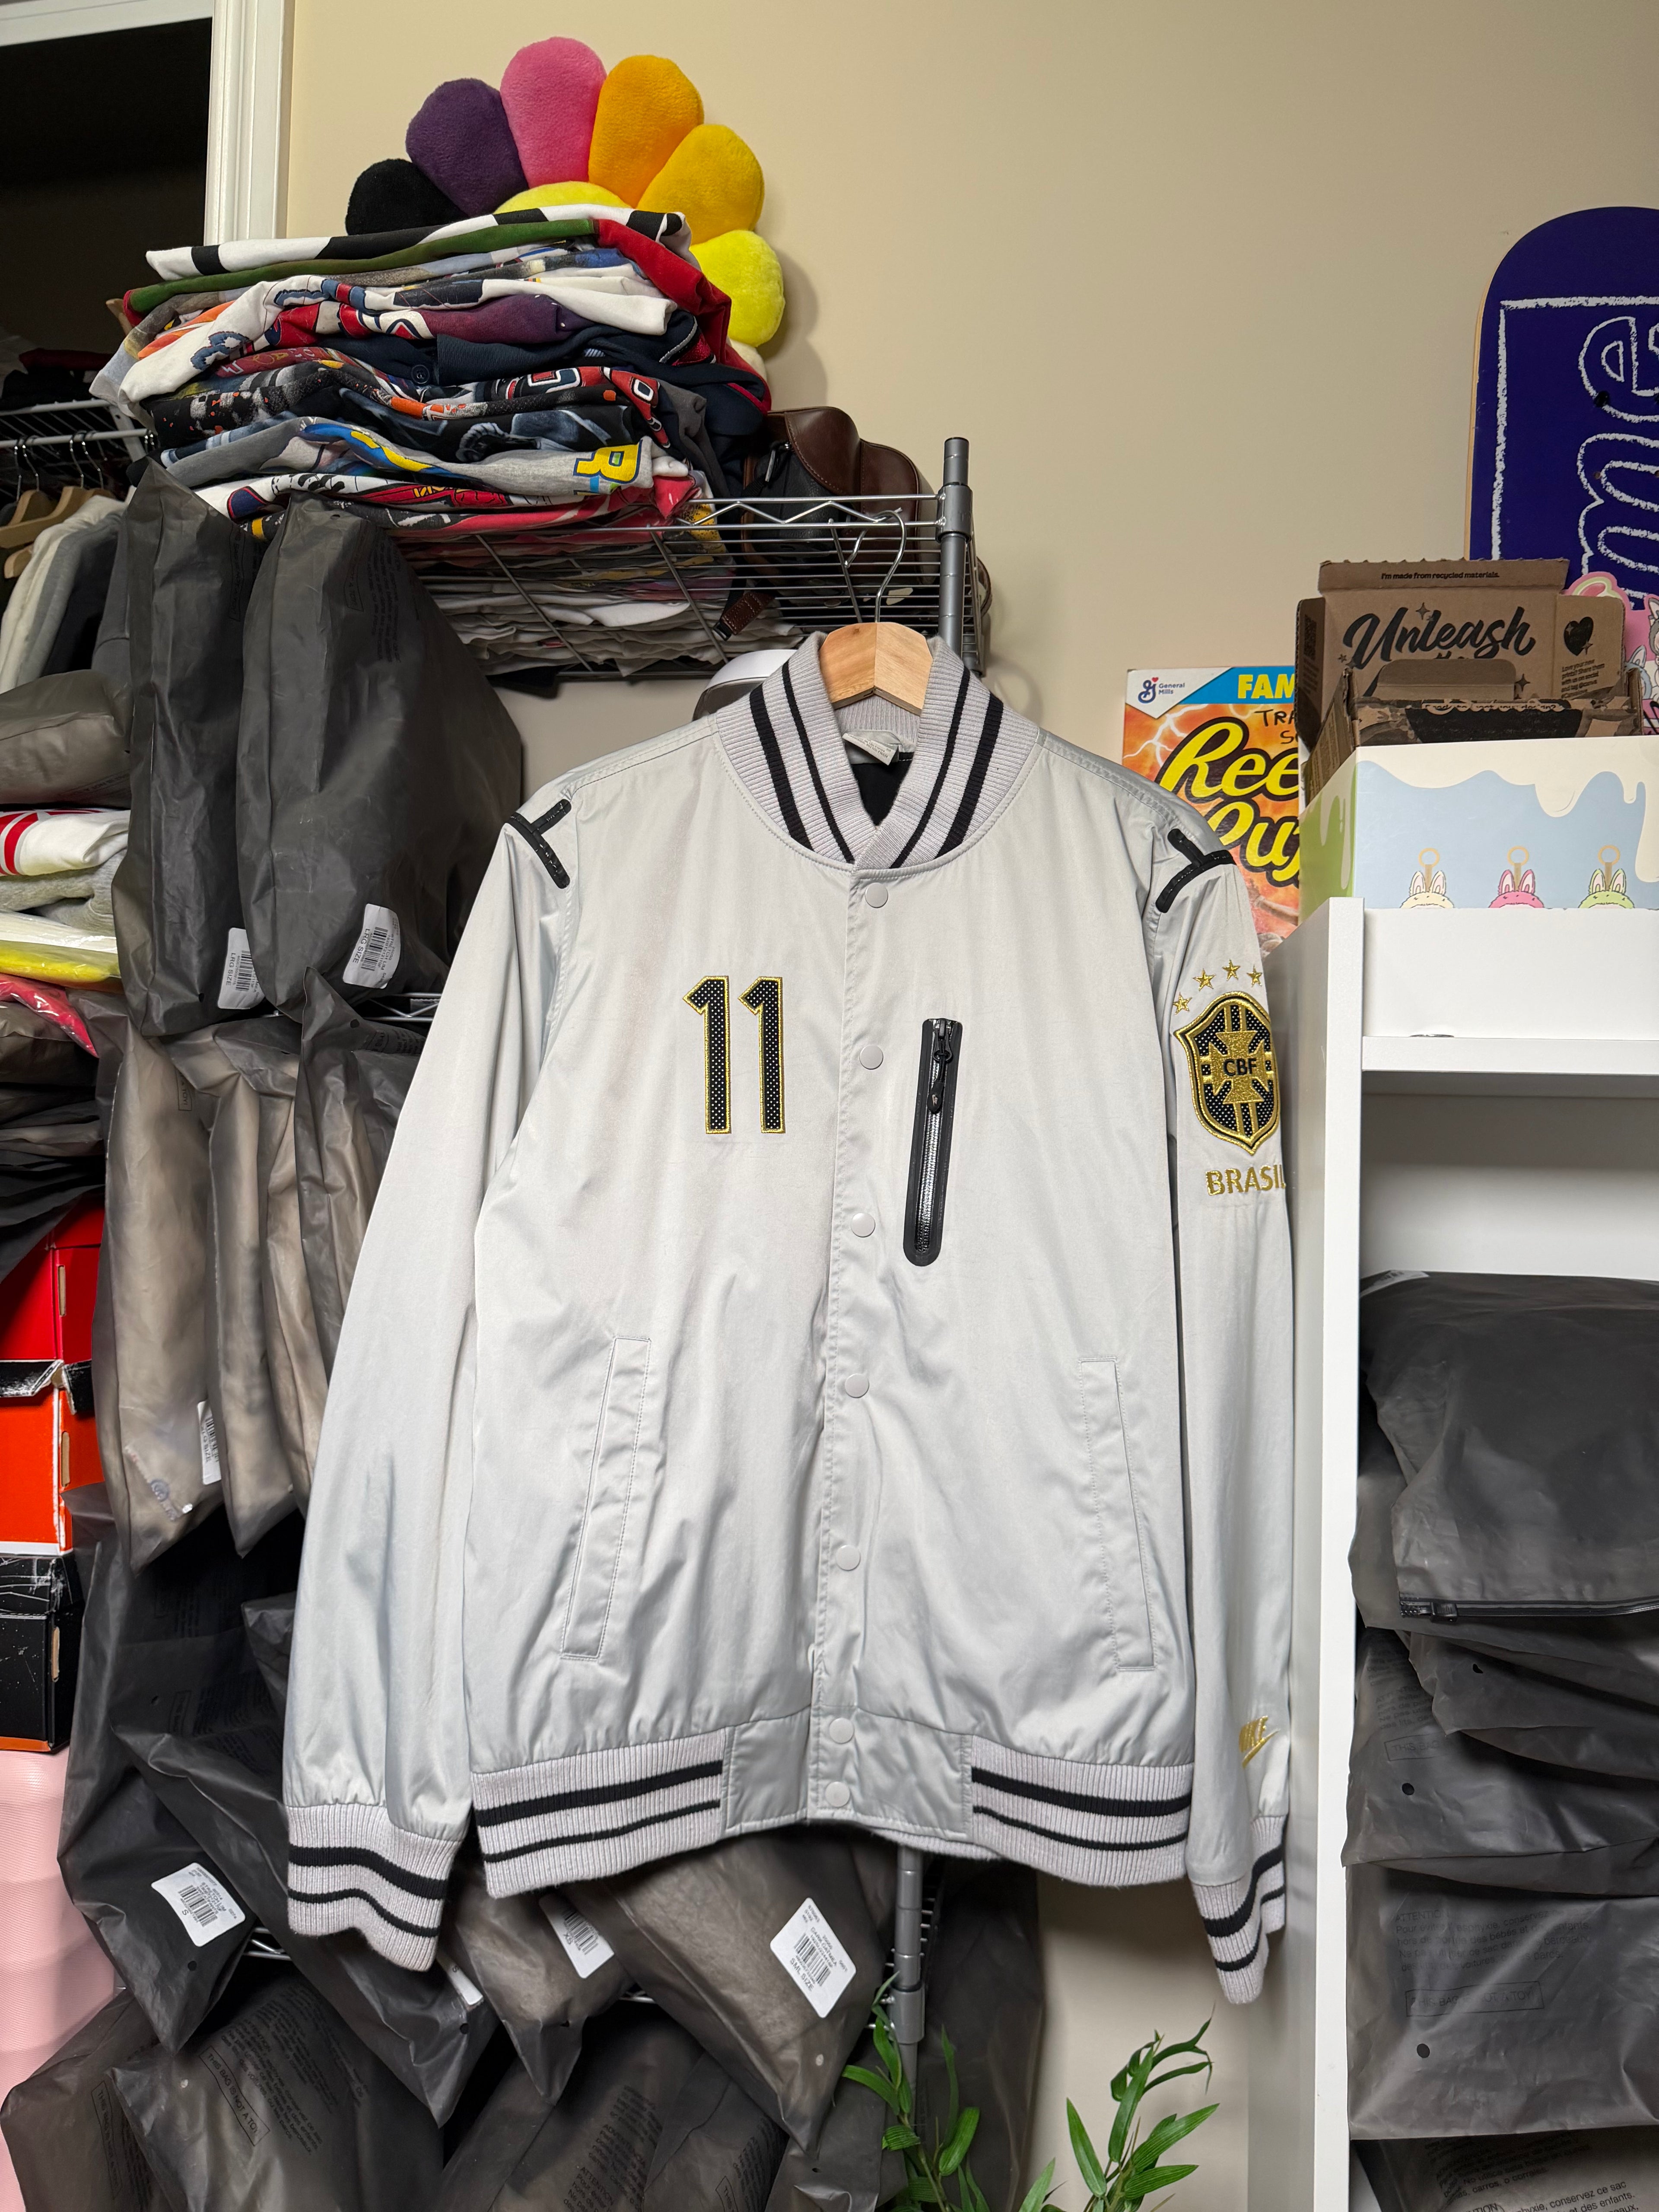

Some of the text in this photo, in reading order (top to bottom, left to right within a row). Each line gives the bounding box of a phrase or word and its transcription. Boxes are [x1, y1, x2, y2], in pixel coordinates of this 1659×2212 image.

[1343, 606, 1536, 669] Unleash
[352, 928, 370, 964] LRG SIZE
[226, 969, 234, 986] SIZE
[683, 976, 785, 1134] 11
[1223, 1058, 1258, 1077] CBF
[1205, 1164, 1286, 1196] BRASIL
[181, 1908, 189, 1916] S
[563, 1932, 574, 1945] XS
[1519, 1925, 1528, 1934] et
[788, 1957, 816, 1992] SML SIZE
[206, 2051, 251, 2120] THIS BAG IS NOT A
[1472, 2180, 1502, 2193] carros,
[1549, 2181, 1627, 2208] conservez ce sac
[1580, 2201, 1598, 2212] des
[1599, 2191, 1635, 2207] enfants.
